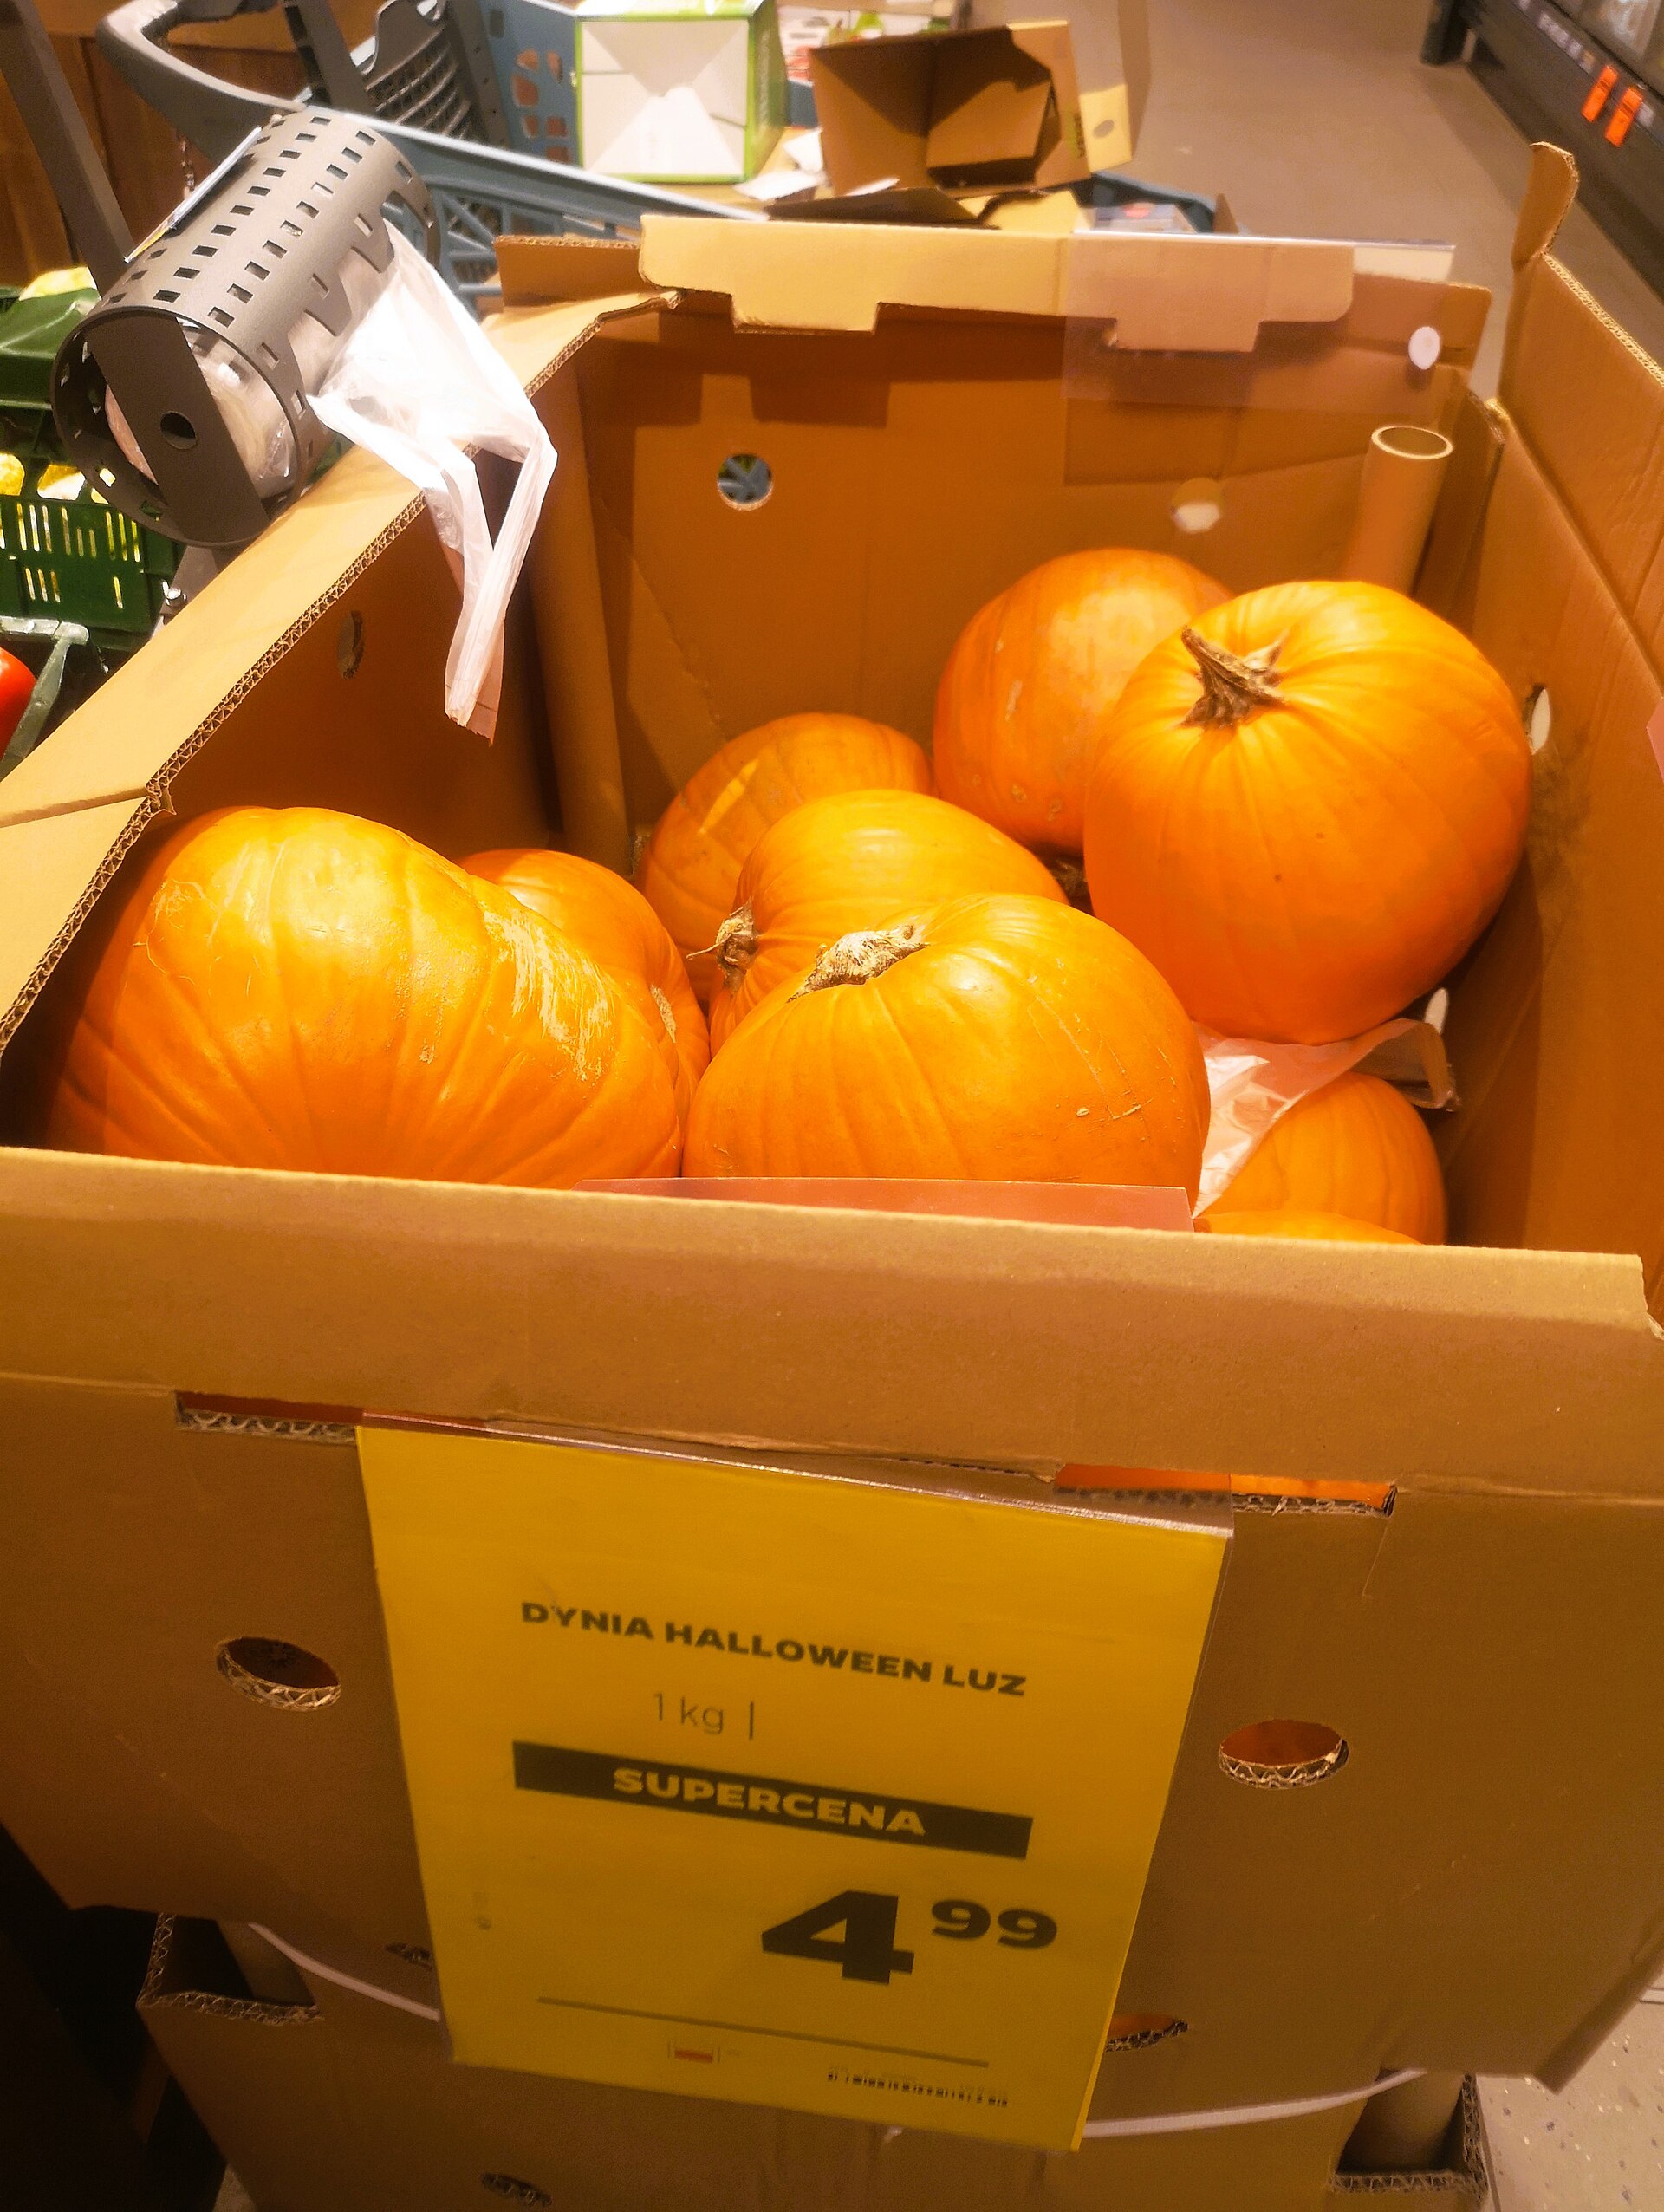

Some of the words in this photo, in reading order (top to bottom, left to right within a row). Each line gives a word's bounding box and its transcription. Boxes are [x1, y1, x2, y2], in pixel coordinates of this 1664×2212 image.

[522, 1601, 653, 1641] DYNIA
[665, 1622, 933, 1682] HALLOWEEN
[942, 1664, 1027, 1697] LUZ
[653, 1692, 665, 1722] 1
[679, 1696, 725, 1736] kg
[612, 1766, 926, 1836] SUPERCENA
[761, 1890, 916, 1985] 4
[930, 1898, 1059, 1950] 99
